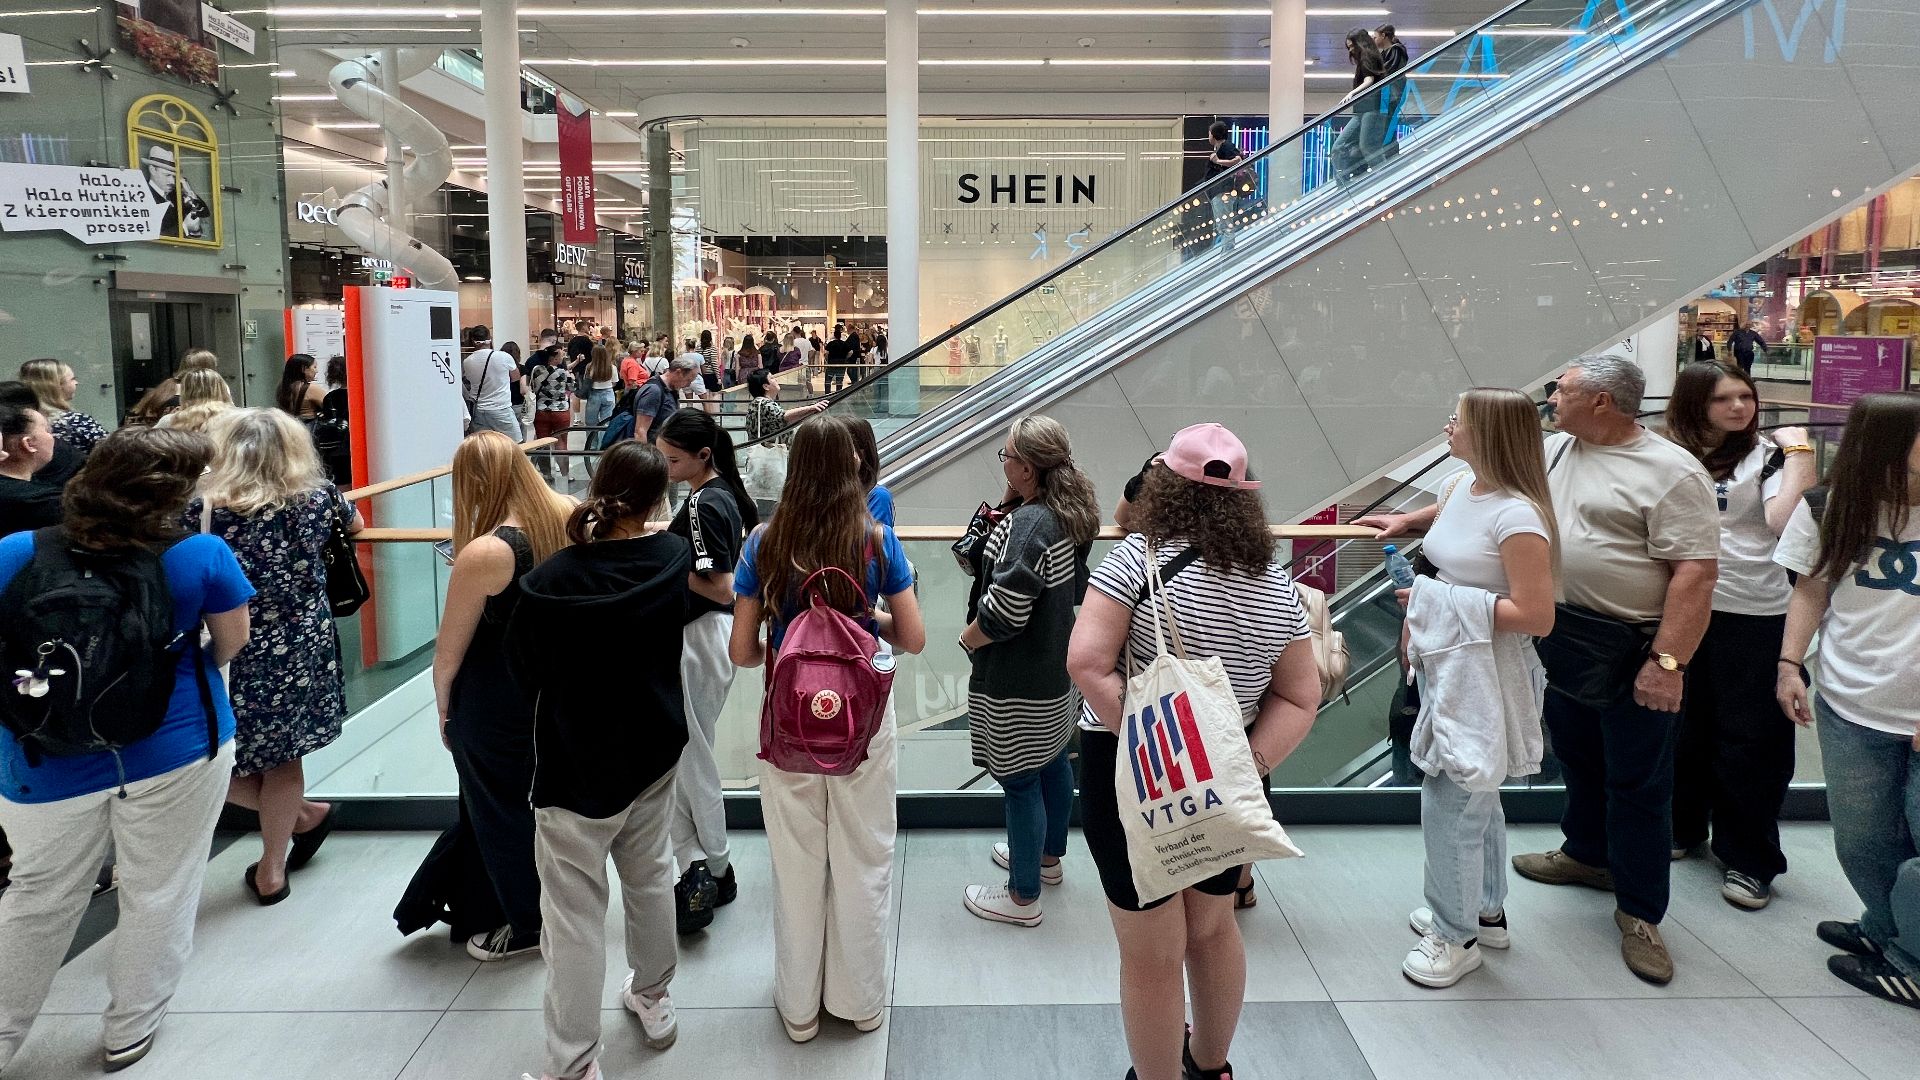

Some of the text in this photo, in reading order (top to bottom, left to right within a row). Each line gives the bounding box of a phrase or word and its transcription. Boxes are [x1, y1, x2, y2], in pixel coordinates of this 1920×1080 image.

[80, 173, 141, 188] Halo...
[957, 173, 1096, 204] SHEIN
[25, 187, 145, 203] Hala Hutnik?
[577, 176, 586, 231] PODARUNKOWA
[4, 203, 150, 218] Z kierownikiem
[86, 221, 151, 236] proszę!
[695, 557, 713, 571] NIKE
[1141, 787, 1223, 830] VTGA
[1154, 832, 1206, 855] Verband der
[1160, 844, 1212, 867] technischen
[1166, 846, 1246, 876] Gebäudeausrüster
